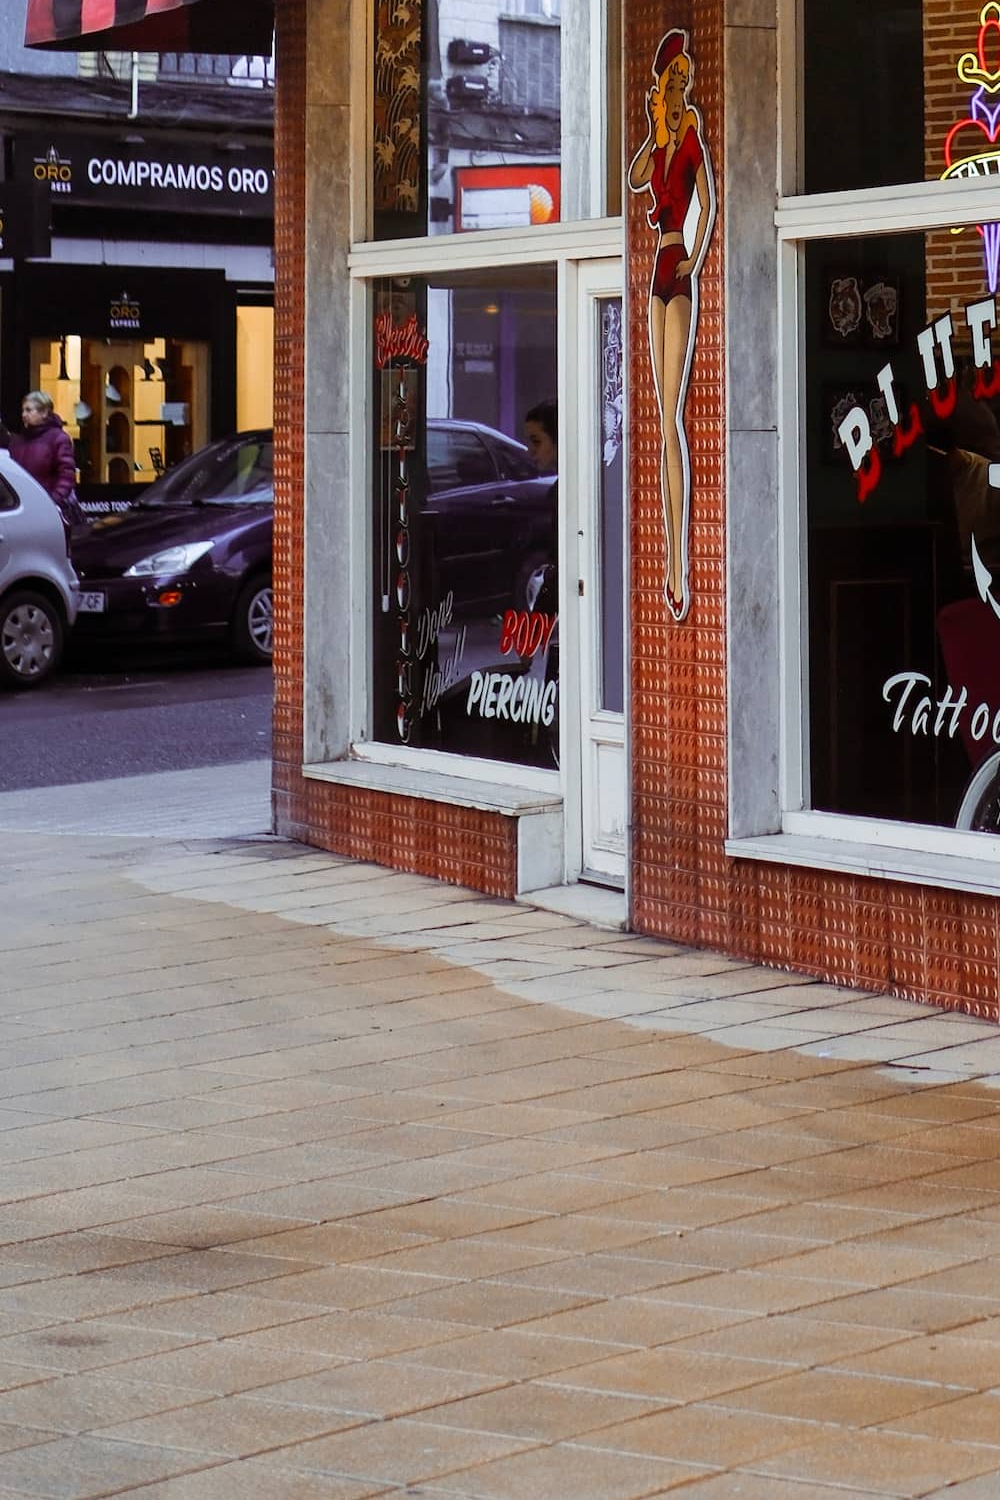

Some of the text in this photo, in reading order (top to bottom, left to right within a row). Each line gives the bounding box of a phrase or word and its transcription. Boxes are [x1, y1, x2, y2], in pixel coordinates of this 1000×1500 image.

[33, 164, 72, 182] ORO
[87, 157, 270, 195] COMPRAMOS ORO
[110, 306, 140, 319] ORO
[499, 609, 559, 660] BODY
[466, 671, 557, 727] PIERCING
